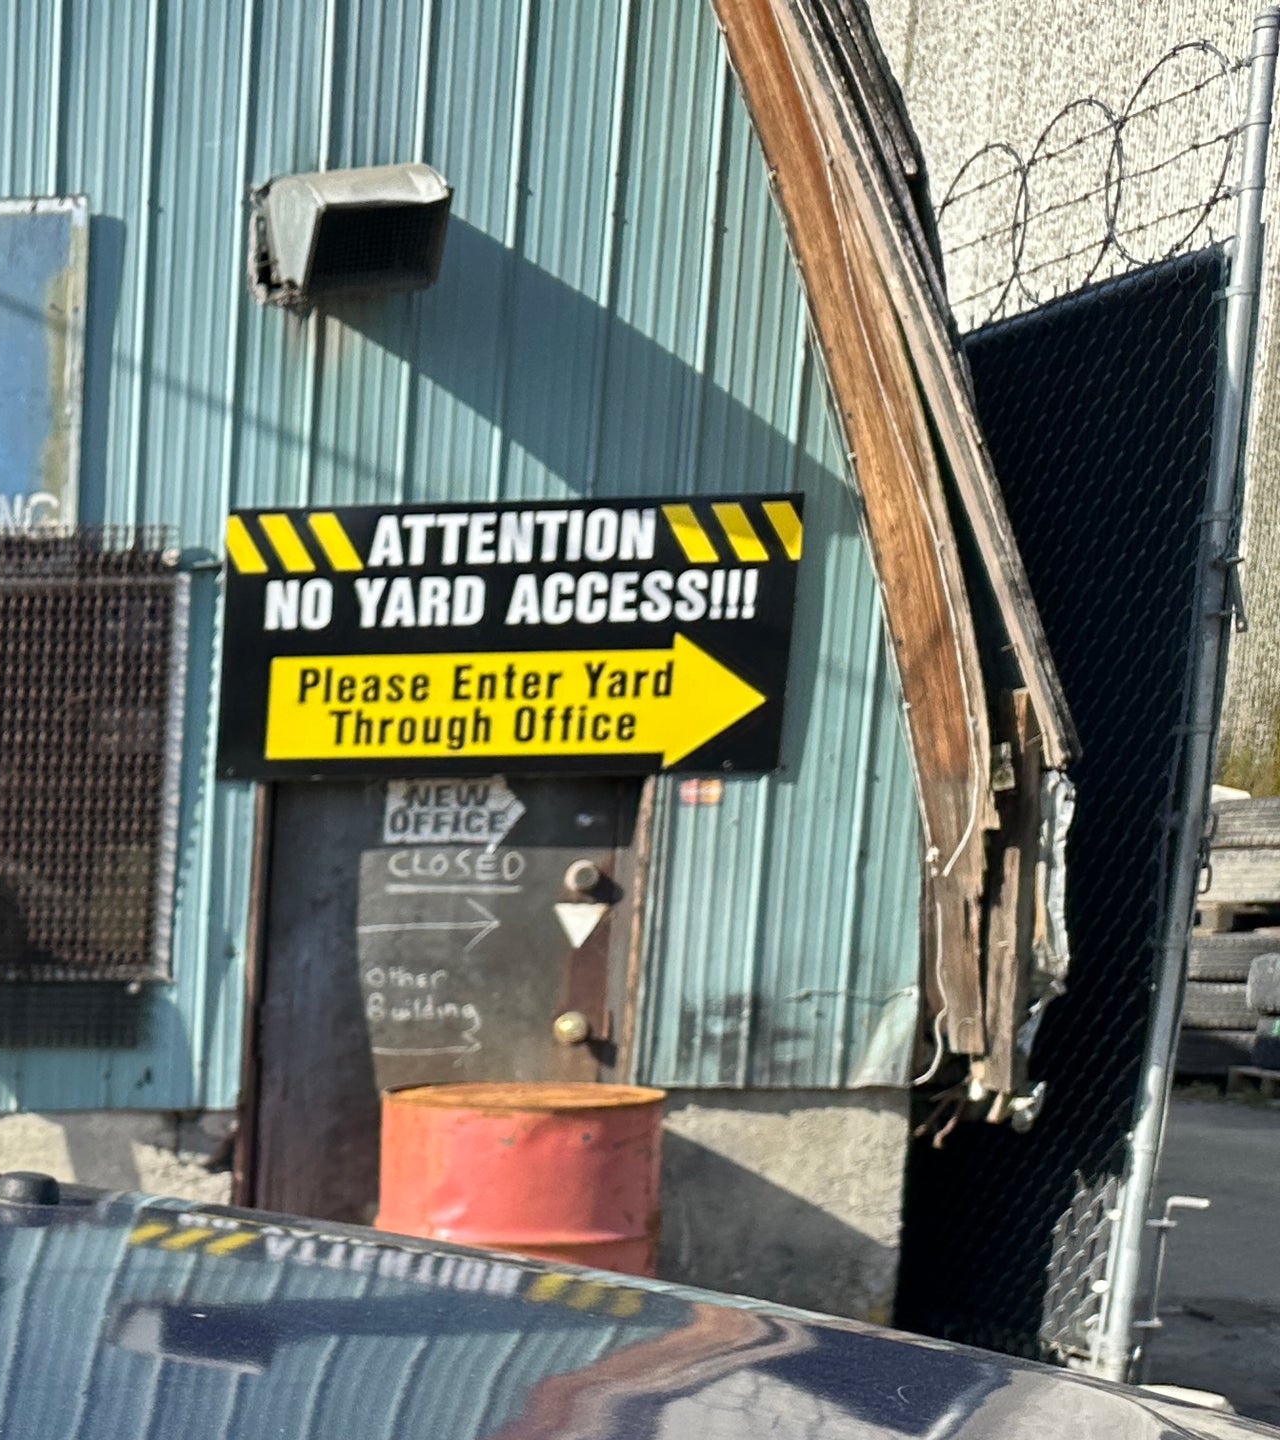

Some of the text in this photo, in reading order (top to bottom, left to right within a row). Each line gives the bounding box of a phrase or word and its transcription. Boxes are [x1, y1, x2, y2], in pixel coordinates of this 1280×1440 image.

[366, 508, 657, 568] ATTENTION
[264, 568, 759, 631] NO YARD ACCESS!!!
[297, 660, 675, 704] Please Enter Yard
[329, 704, 637, 750] Through Office
[405, 784, 491, 807] NEW
[390, 808, 507, 834] OFFICE
[388, 849, 527, 881] CLOSED
